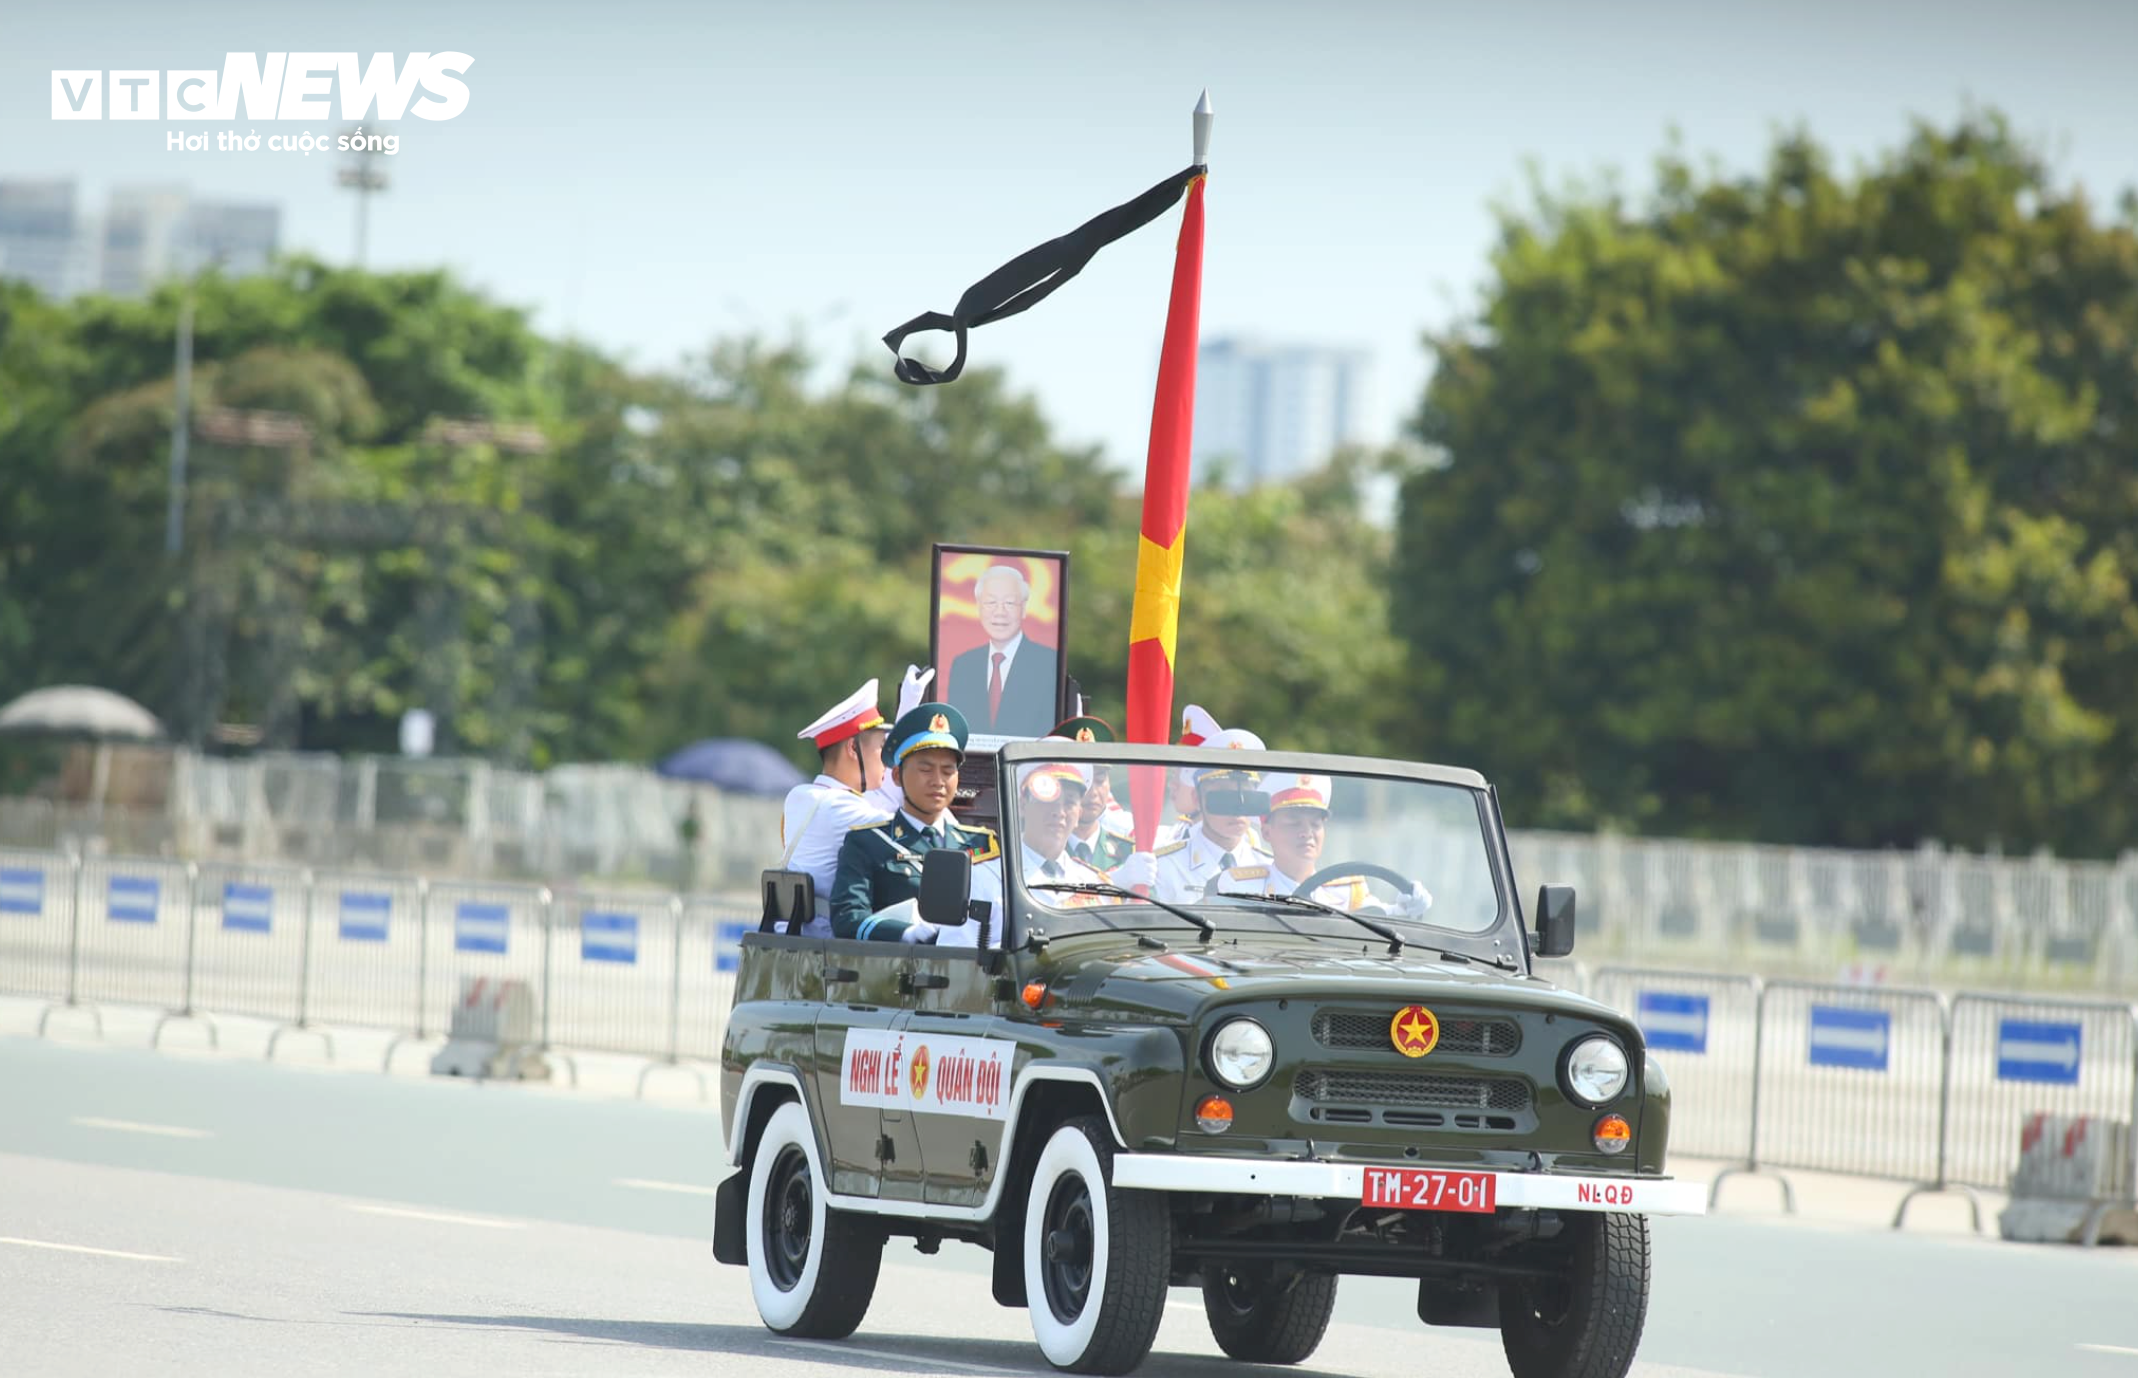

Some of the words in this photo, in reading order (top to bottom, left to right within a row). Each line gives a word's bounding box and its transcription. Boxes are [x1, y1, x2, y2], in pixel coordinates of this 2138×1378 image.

[850, 1049, 882, 1094] NGHI
[936, 1049, 975, 1105] QUÂN
[976, 1051, 1002, 1115] ĐỘI
[1368, 1171, 1487, 1208] TM-27-01
